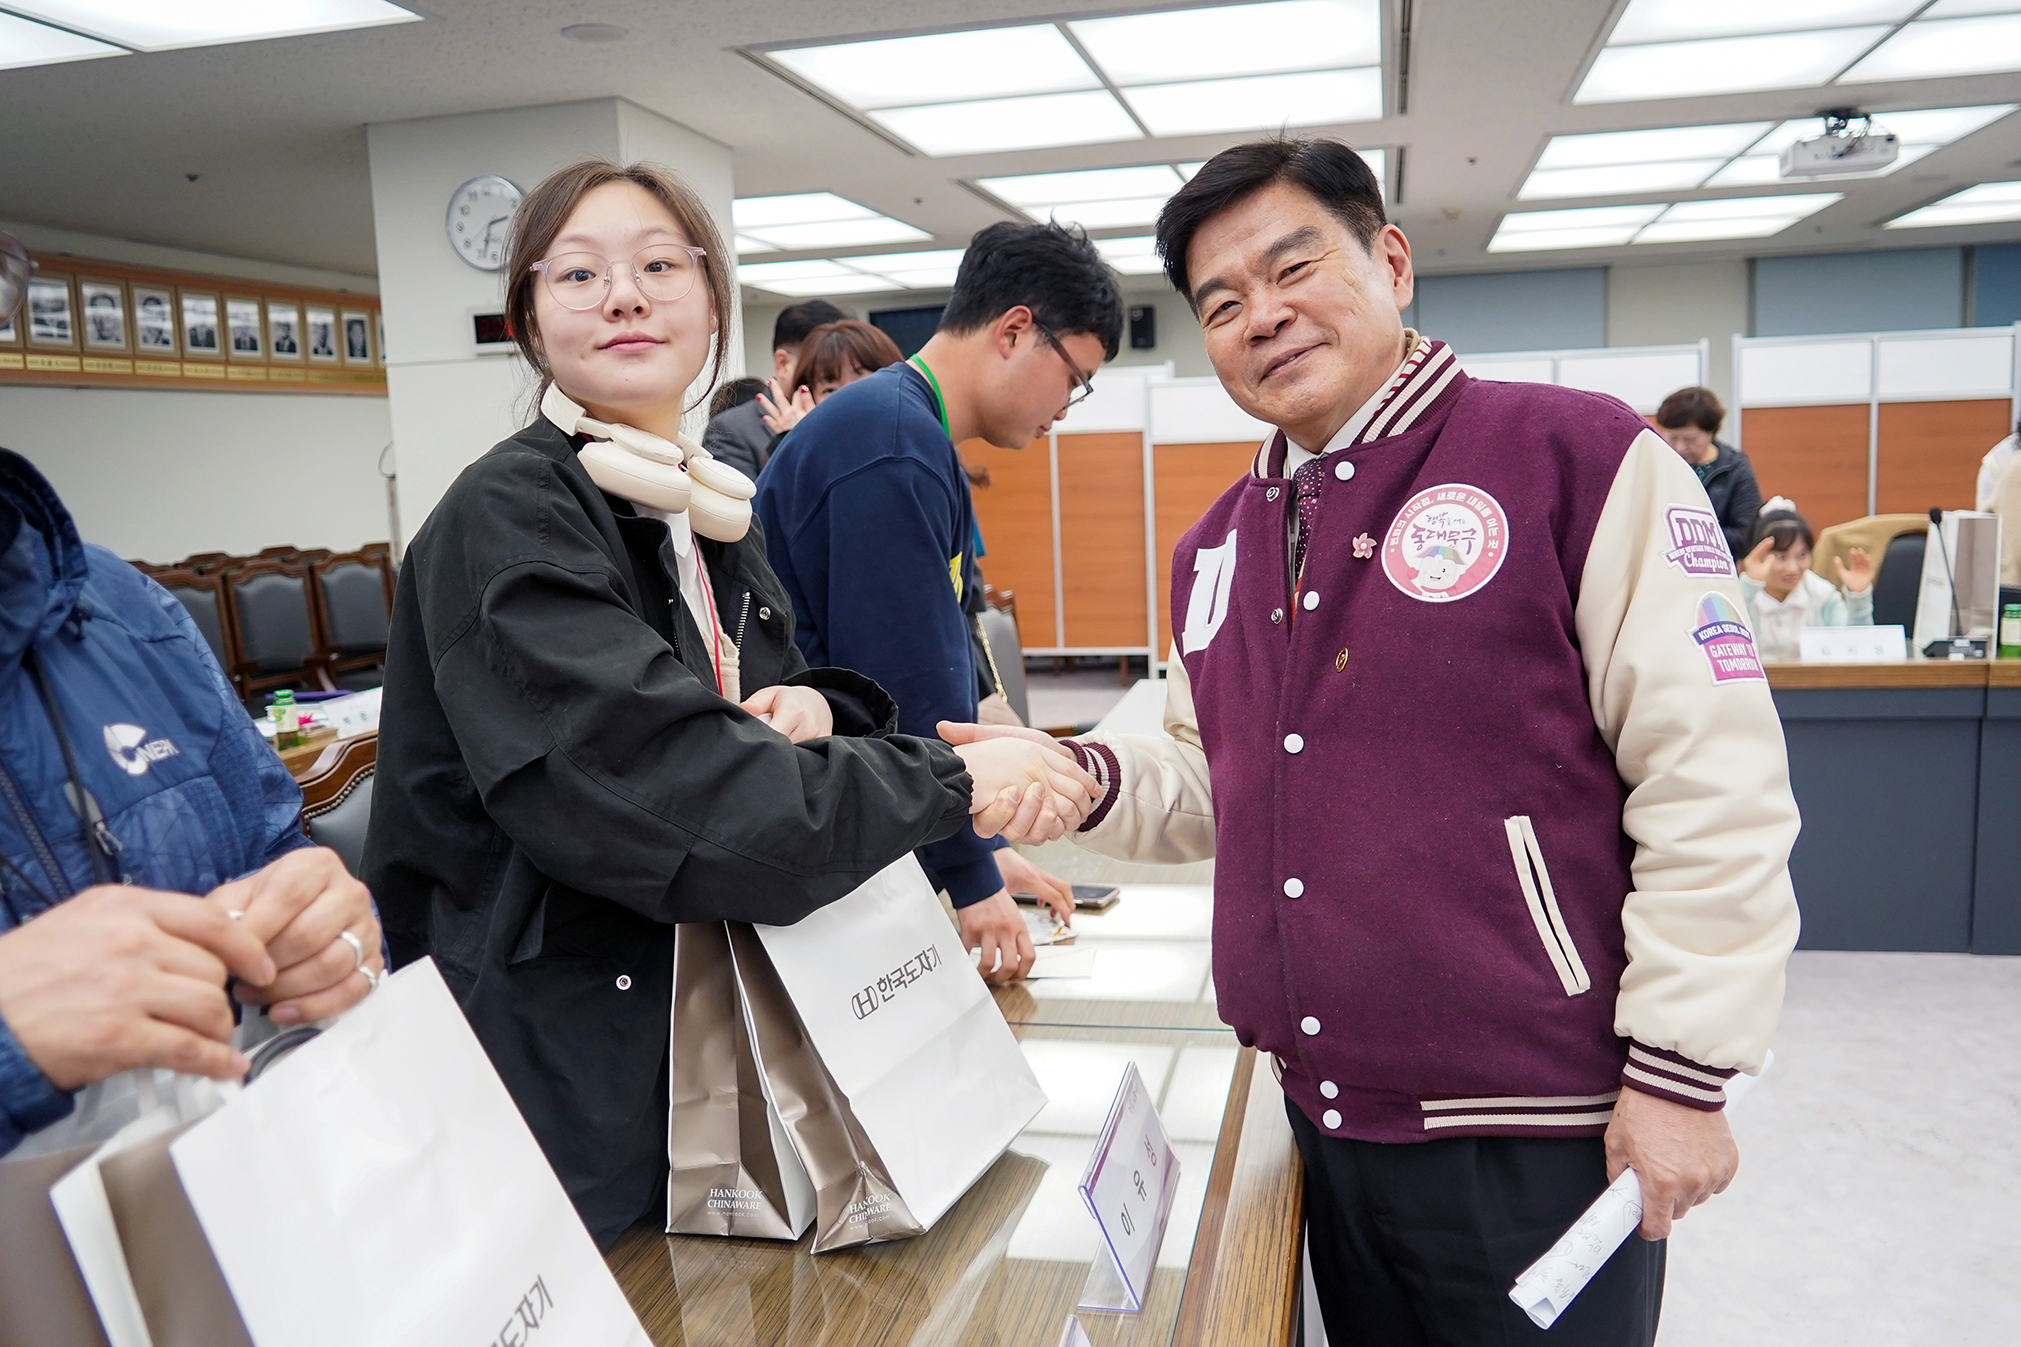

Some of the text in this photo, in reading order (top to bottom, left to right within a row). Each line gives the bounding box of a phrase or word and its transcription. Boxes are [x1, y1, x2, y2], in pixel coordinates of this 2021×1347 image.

[1436, 491, 1467, 502] 새로운
[1486, 517, 1500, 537] 여는
[1674, 517, 1722, 549] DDM
[1411, 523, 1477, 555] 동대문구
[1487, 539, 1499, 550] 곳
[1683, 552, 1729, 573] Champion
[1698, 624, 1724, 641] KOREA
[1721, 623, 1740, 634] SEOUL
[1708, 643, 1748, 658] GATEWAY
[876, 943, 942, 1003] 한국도자기
[710, 1188, 763, 1200] HANKOOK
[850, 1193, 892, 1214] HANOOK
[707, 1199, 762, 1210] CHINAWARE
